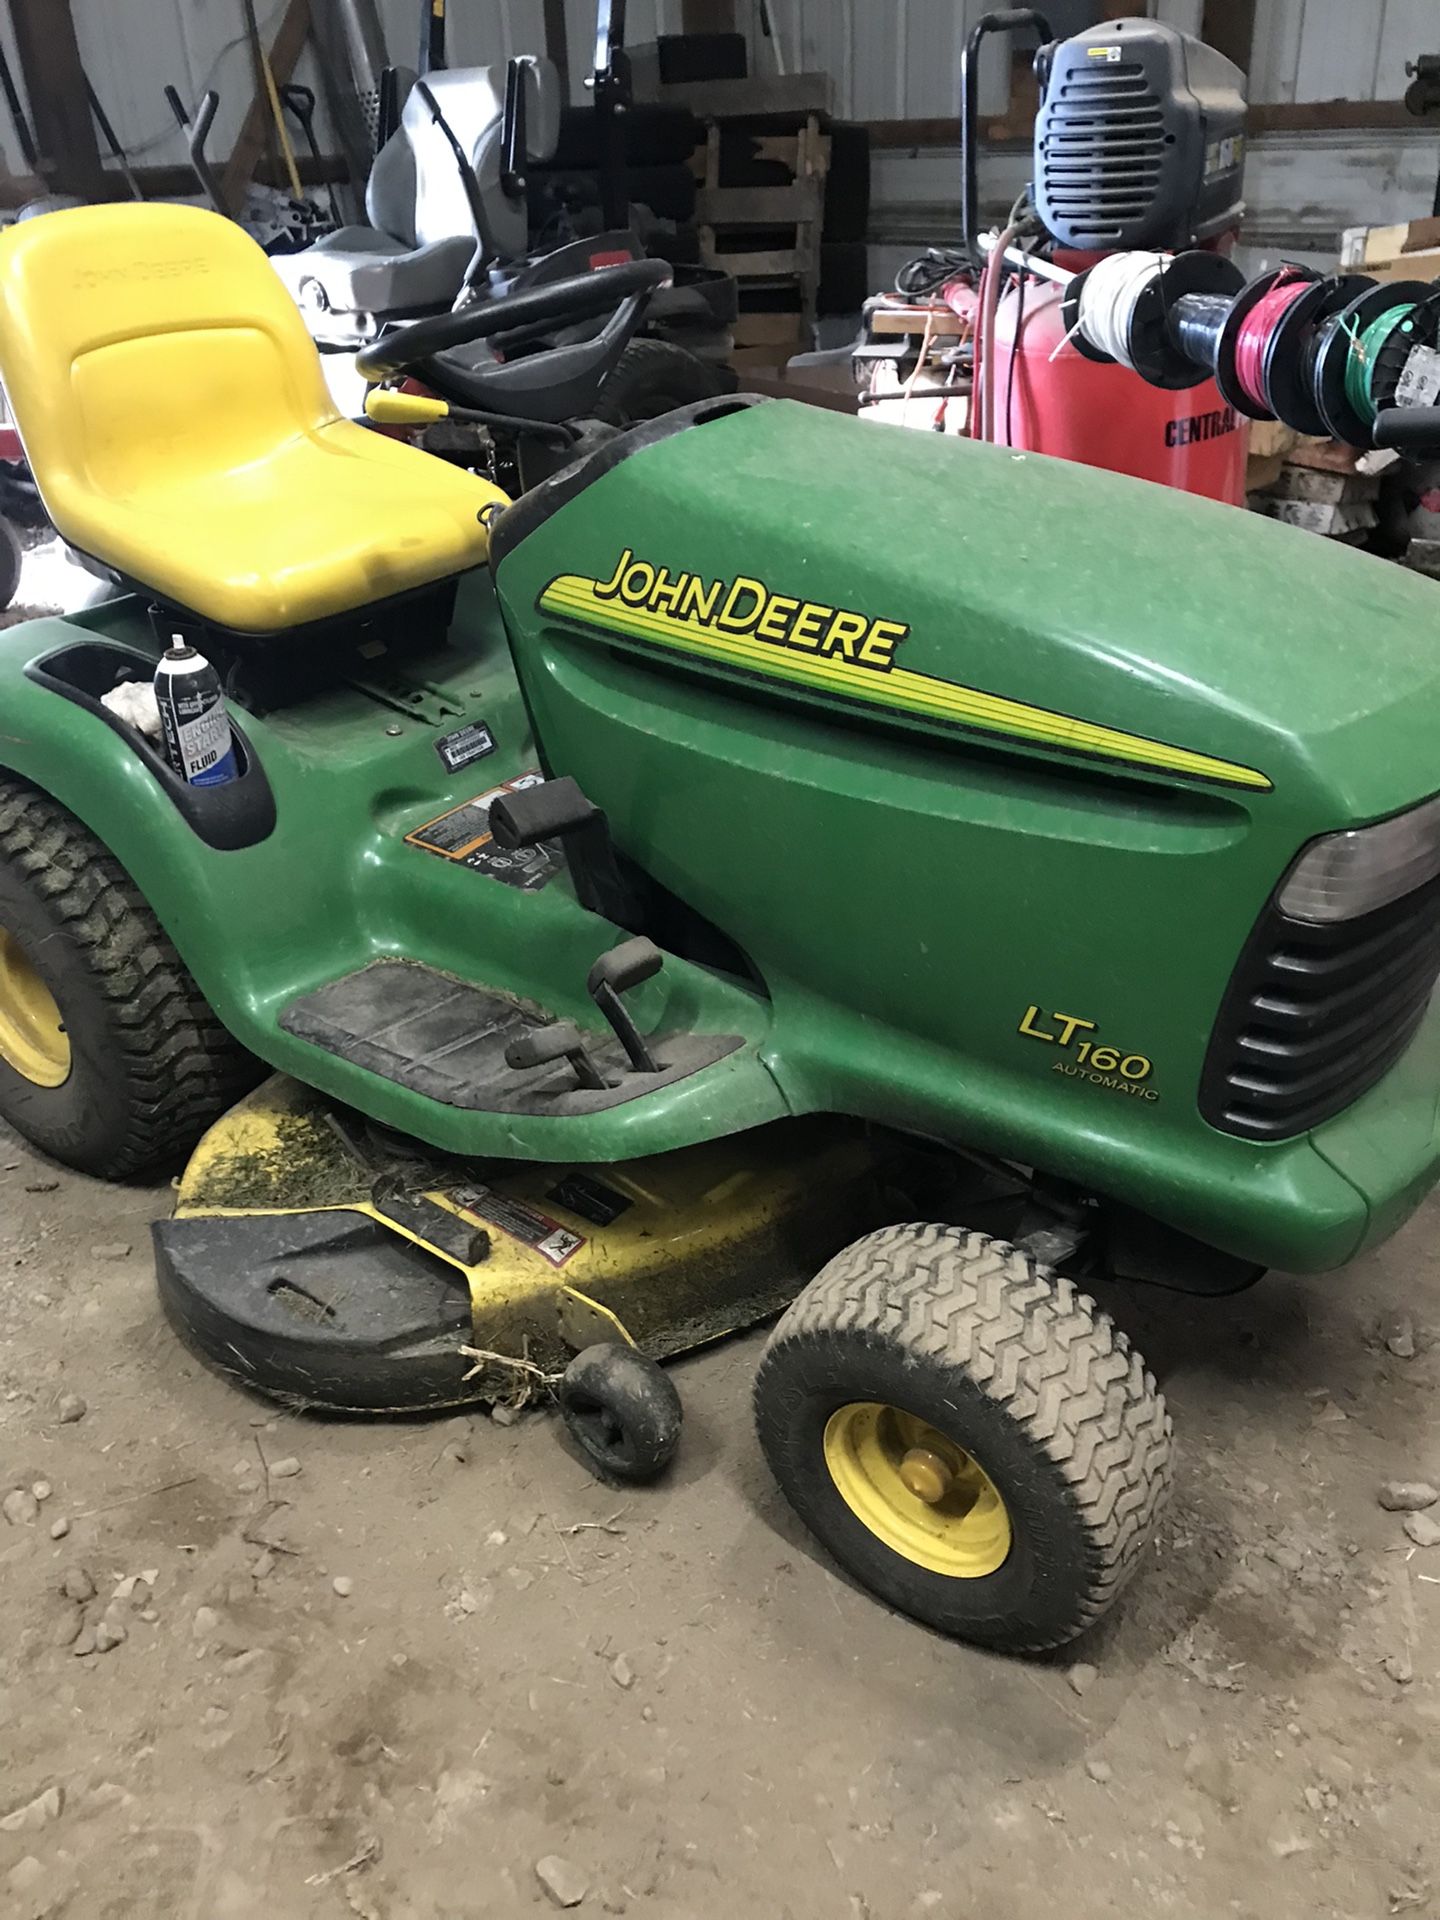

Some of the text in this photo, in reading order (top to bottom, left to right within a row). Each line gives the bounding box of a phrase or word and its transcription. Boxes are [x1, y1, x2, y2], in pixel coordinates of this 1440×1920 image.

[593, 548, 912, 673] JOHN DEERE
[190, 750, 218, 774] FLUID
[1052, 1062, 1160, 1100] AUTOMATIC
